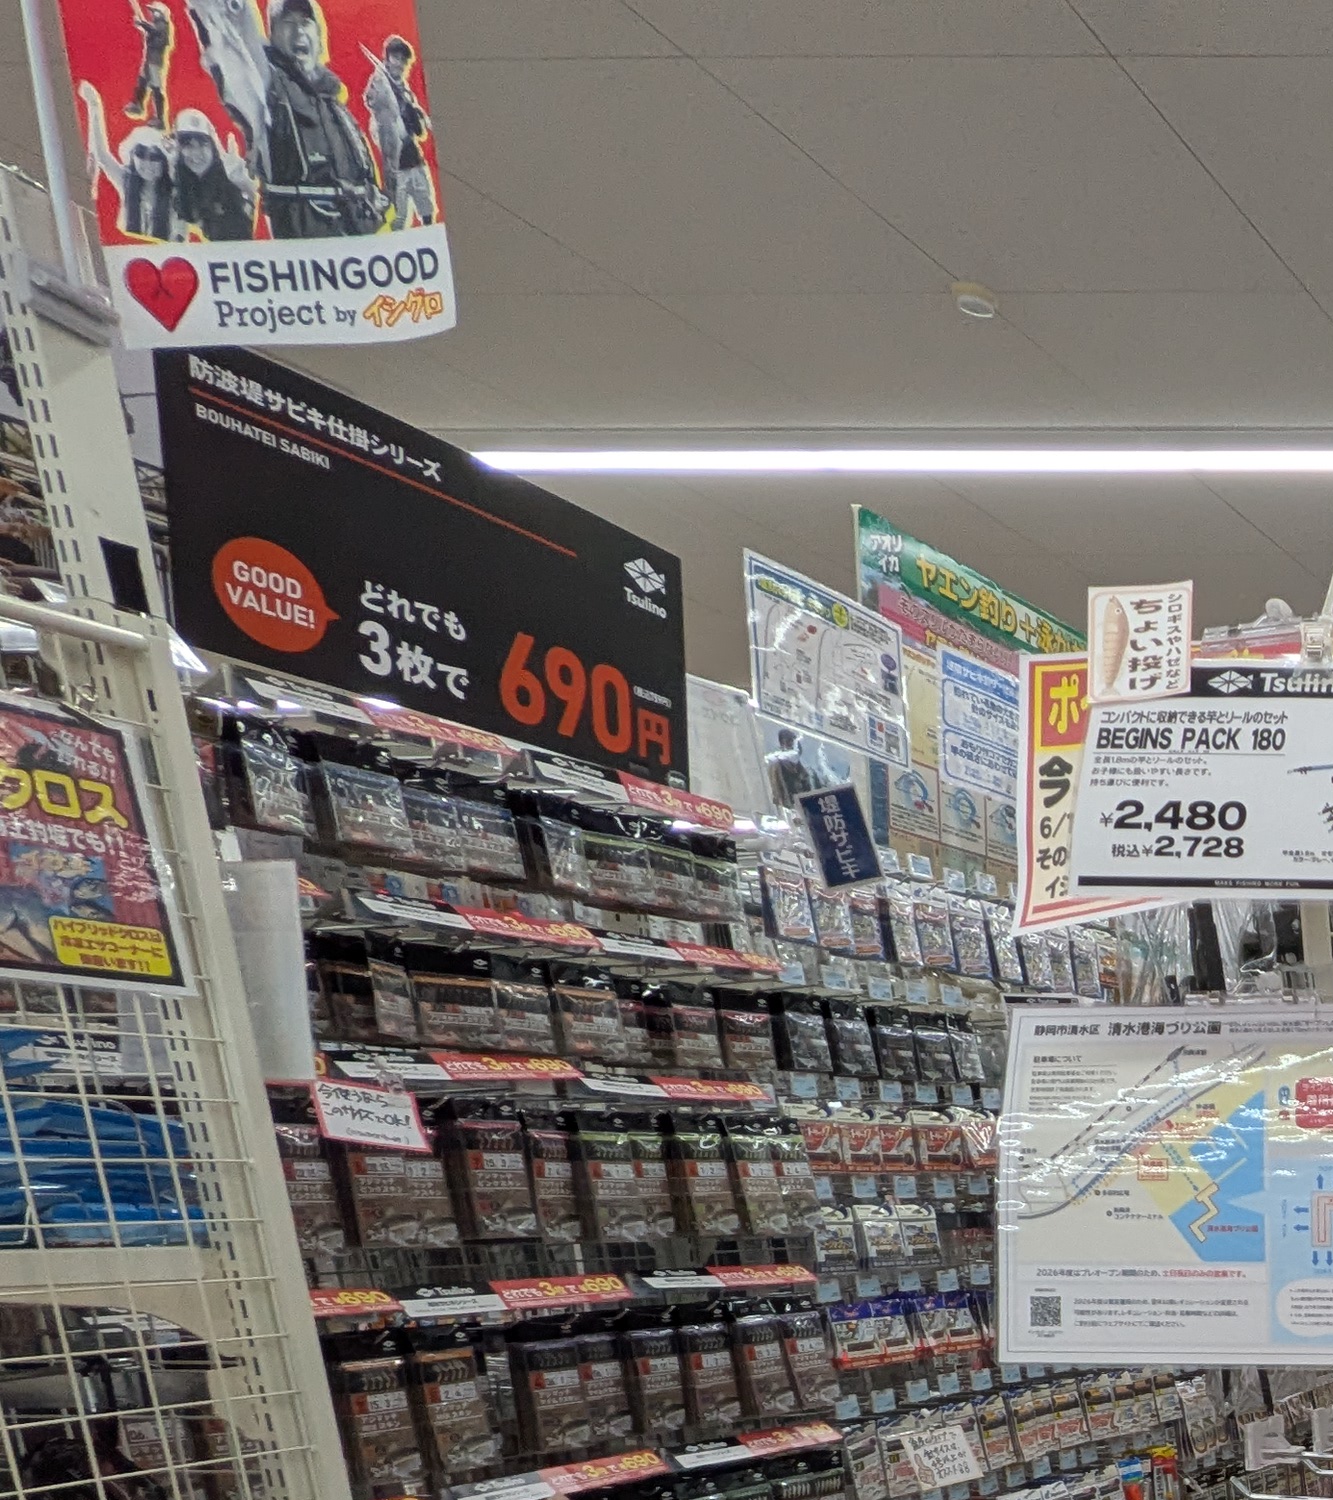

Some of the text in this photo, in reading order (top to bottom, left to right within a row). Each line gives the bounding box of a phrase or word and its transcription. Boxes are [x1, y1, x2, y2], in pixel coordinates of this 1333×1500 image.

[208, 246, 440, 294] FISHINGOOD
[214, 300, 329, 333] Project
[334, 303, 358, 327] by
[195, 401, 331, 470] BOUHATEI SABIKI
[231, 558, 302, 599] GOOD
[225, 583, 316, 630] VALUE!
[359, 580, 468, 641] どれでも
[623, 586, 668, 619] Tsulino
[358, 620, 469, 700] 3枚で
[1128, 598, 1164, 692] ちょい投げ
[500, 631, 672, 766] 690円
[1100, 710, 1288, 725] コンパクトに収納できる竿とリールのセット
[1096, 728, 1286, 751] BEGINS PACK 180
[1100, 800, 1247, 832] ¥2,480
[1111, 836, 1244, 859] 税込¥2,728
